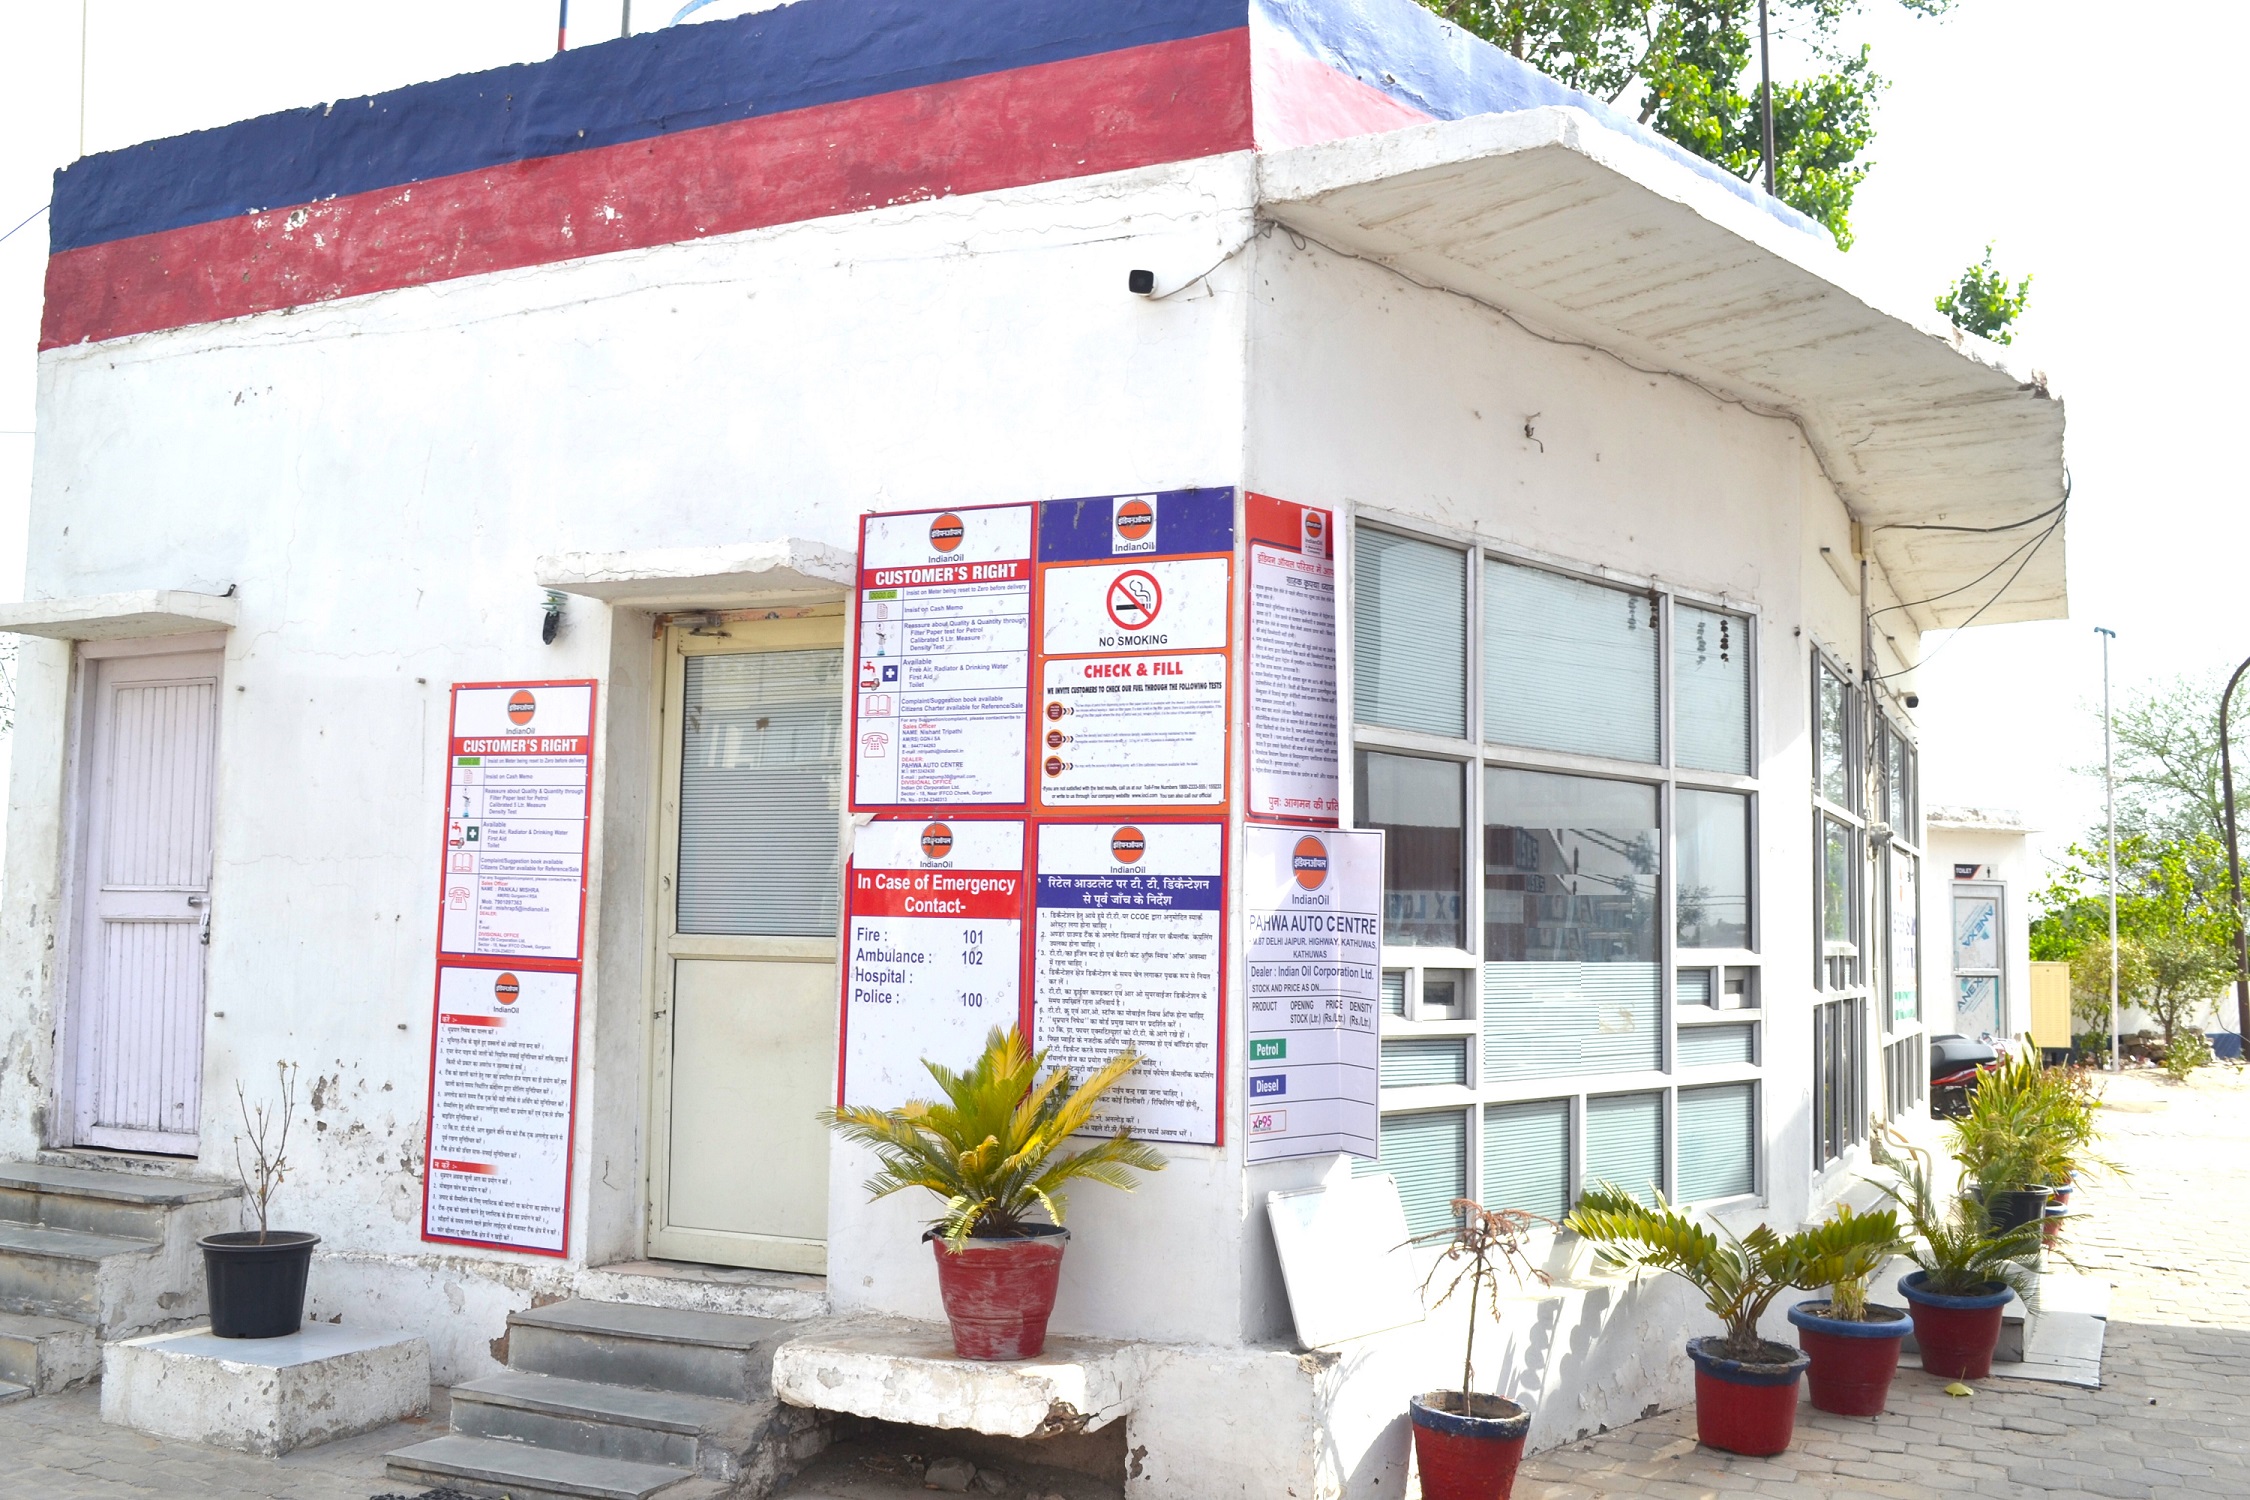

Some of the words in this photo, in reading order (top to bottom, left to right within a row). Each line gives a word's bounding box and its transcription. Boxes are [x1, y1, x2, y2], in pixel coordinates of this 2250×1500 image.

[1115, 541, 1155, 552] IndianOil
[928, 553, 965, 563] IndianOil
[875, 566, 969, 586] CUSTOMER'S
[973, 563, 1018, 578] RIGHT
[1099, 637, 1115, 647] NO
[1117, 635, 1168, 646] SMOKING
[1084, 664, 1132, 678] CHECK
[1136, 663, 1148, 676] &
[1153, 662, 1184, 675] FILL
[1047, 687, 1054, 695] WE
[1071, 686, 1098, 694] CUSTOMERS
[1106, 685, 1121, 693] CHECK
[1133, 684, 1144, 692] FUEL
[1179, 682, 1208, 690] FOLLOWING
[505, 727, 535, 735] IndianOil
[463, 740, 538, 752] CUSTOMER'S
[541, 739, 578, 752] RIGHT
[1284, 798, 1311, 809] आगमन
[1313, 797, 1323, 810] की
[919, 860, 953, 868] IndianOil
[1110, 866, 1146, 874] IndianOil
[858, 874, 871, 890] In
[875, 874, 910, 891] Case
[913, 875, 929, 891] of
[933, 876, 1015, 895] Emergency
[1048, 877, 1071, 888] रिटेल
[1074, 877, 1113, 889] आउटलेट
[1116, 879, 1127, 889] पर
[1130, 878, 1143, 889] टी.
[1147, 879, 1160, 890] टी.
[1083, 892, 1091, 904] से
[1134, 894, 1144, 905] के
[1292, 894, 1329, 905] IndianOil
[903, 895, 968, 916] Contact-
[1250, 915, 1288, 931] PAHWA
[1291, 916, 1323, 932] AUTO
[1326, 916, 1376, 935] CENTRE
[1962, 905, 1994, 947] ANEXA
[857, 927, 881, 941] Fire
[963, 930, 983, 944] 101
[1266, 938, 1283, 946] DELHI
[856, 948, 925, 963] Ambulance
[962, 950, 983, 965] 102
[1293, 950, 1328, 958] KATHUWAS
[855, 968, 906, 985] Hospital
[1251, 966, 1272, 977] Dealer
[1278, 966, 1300, 977] Indian
[1301, 966, 1312, 976] Oil
[1313, 967, 1359, 978] Corporation
[1360, 969, 1374, 980] Ltd.
[1252, 984, 1270, 993] STOCK
[1271, 984, 1283, 992] AND
[1284, 983, 1301, 992] PRICE
[1301, 983, 1310, 992] AS
[855, 989, 892, 1003] Police
[961, 993, 983, 1007] 100
[493, 1006, 520, 1014] IndianOil
[1252, 1001, 1277, 1011] PRODUCT
[1290, 1001, 1315, 1010] OPENING
[1325, 1000, 1343, 1011] PRICE
[1349, 1001, 1373, 1013] DENSITY
[1290, 1014, 1309, 1024] STOCK
[1256, 1043, 1279, 1056] Petrol
[1256, 1079, 1279, 1093] Diesel
[1253, 1115, 1272, 1129] XP95
